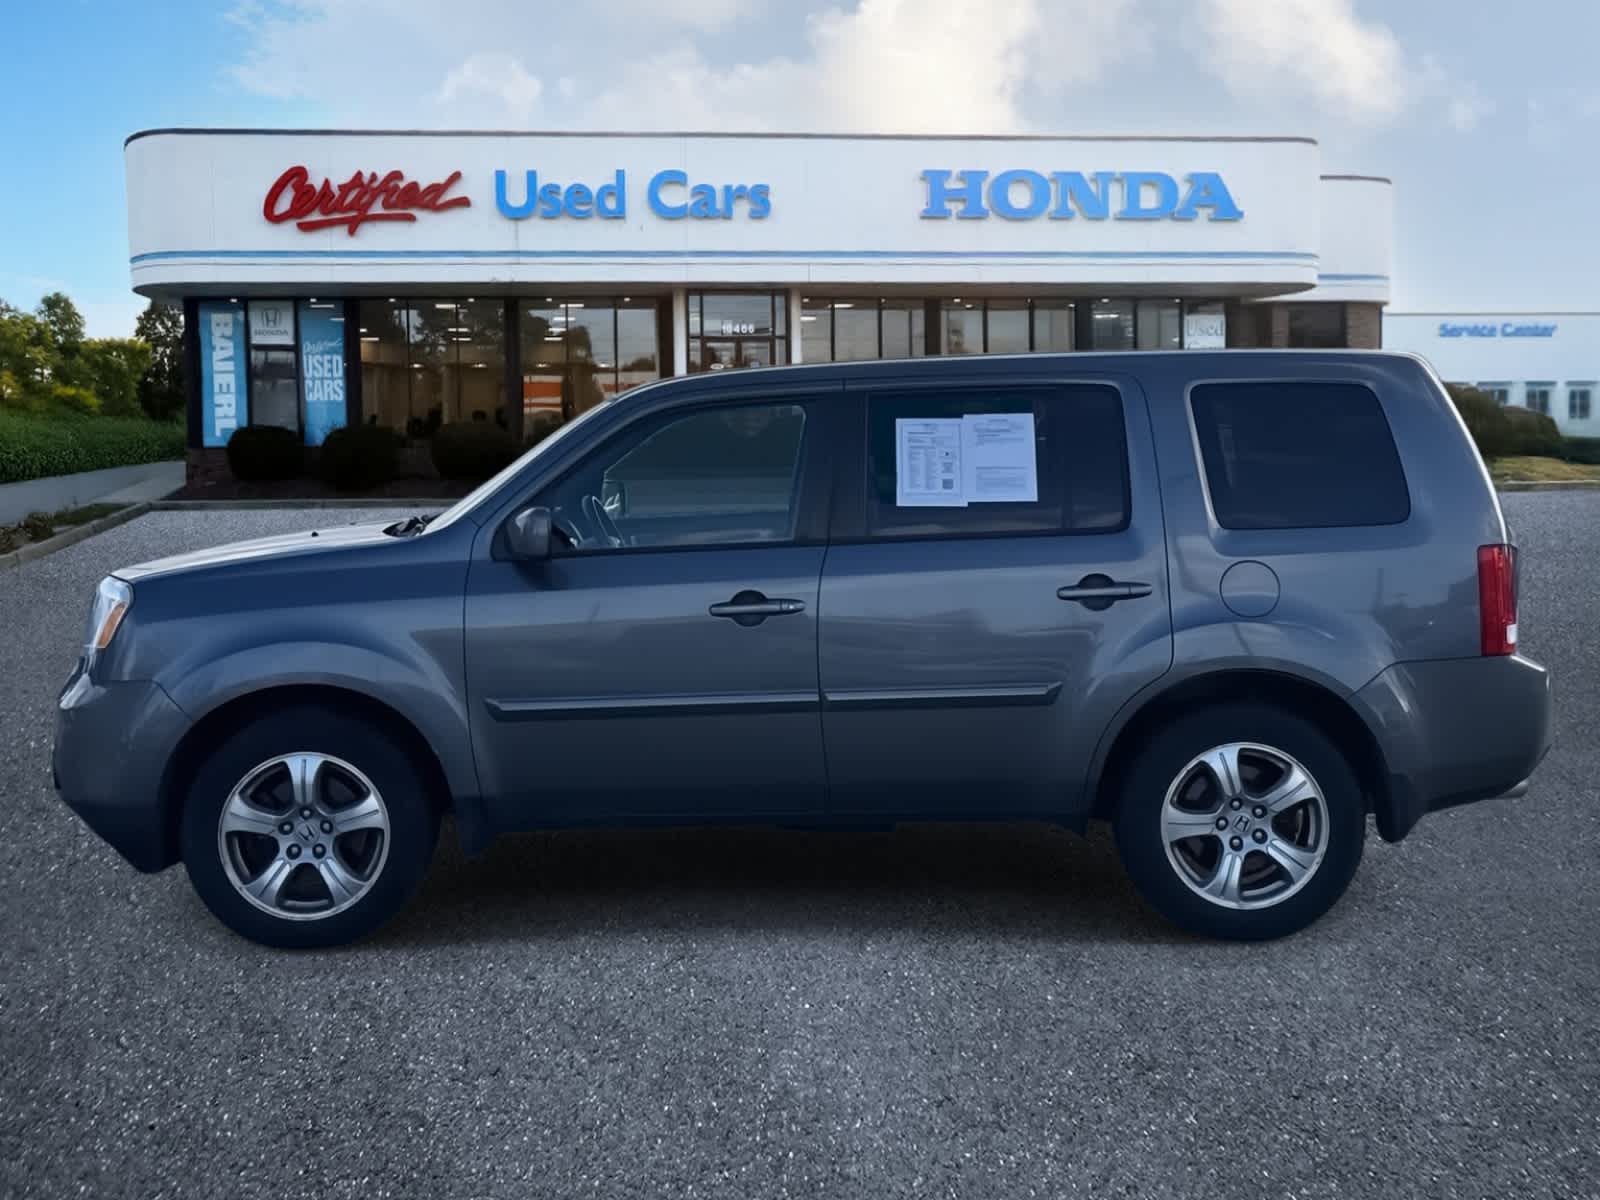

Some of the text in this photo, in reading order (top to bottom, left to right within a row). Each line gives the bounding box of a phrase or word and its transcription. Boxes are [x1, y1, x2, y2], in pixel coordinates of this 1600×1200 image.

[263, 165, 771, 237] Certified Used Cars
[919, 169, 1244, 222] HONDA
[253, 328, 289, 336] HONDA
[1439, 322, 1557, 337] Service Center
[303, 355, 343, 377] USED
[304, 379, 344, 401] CARS
